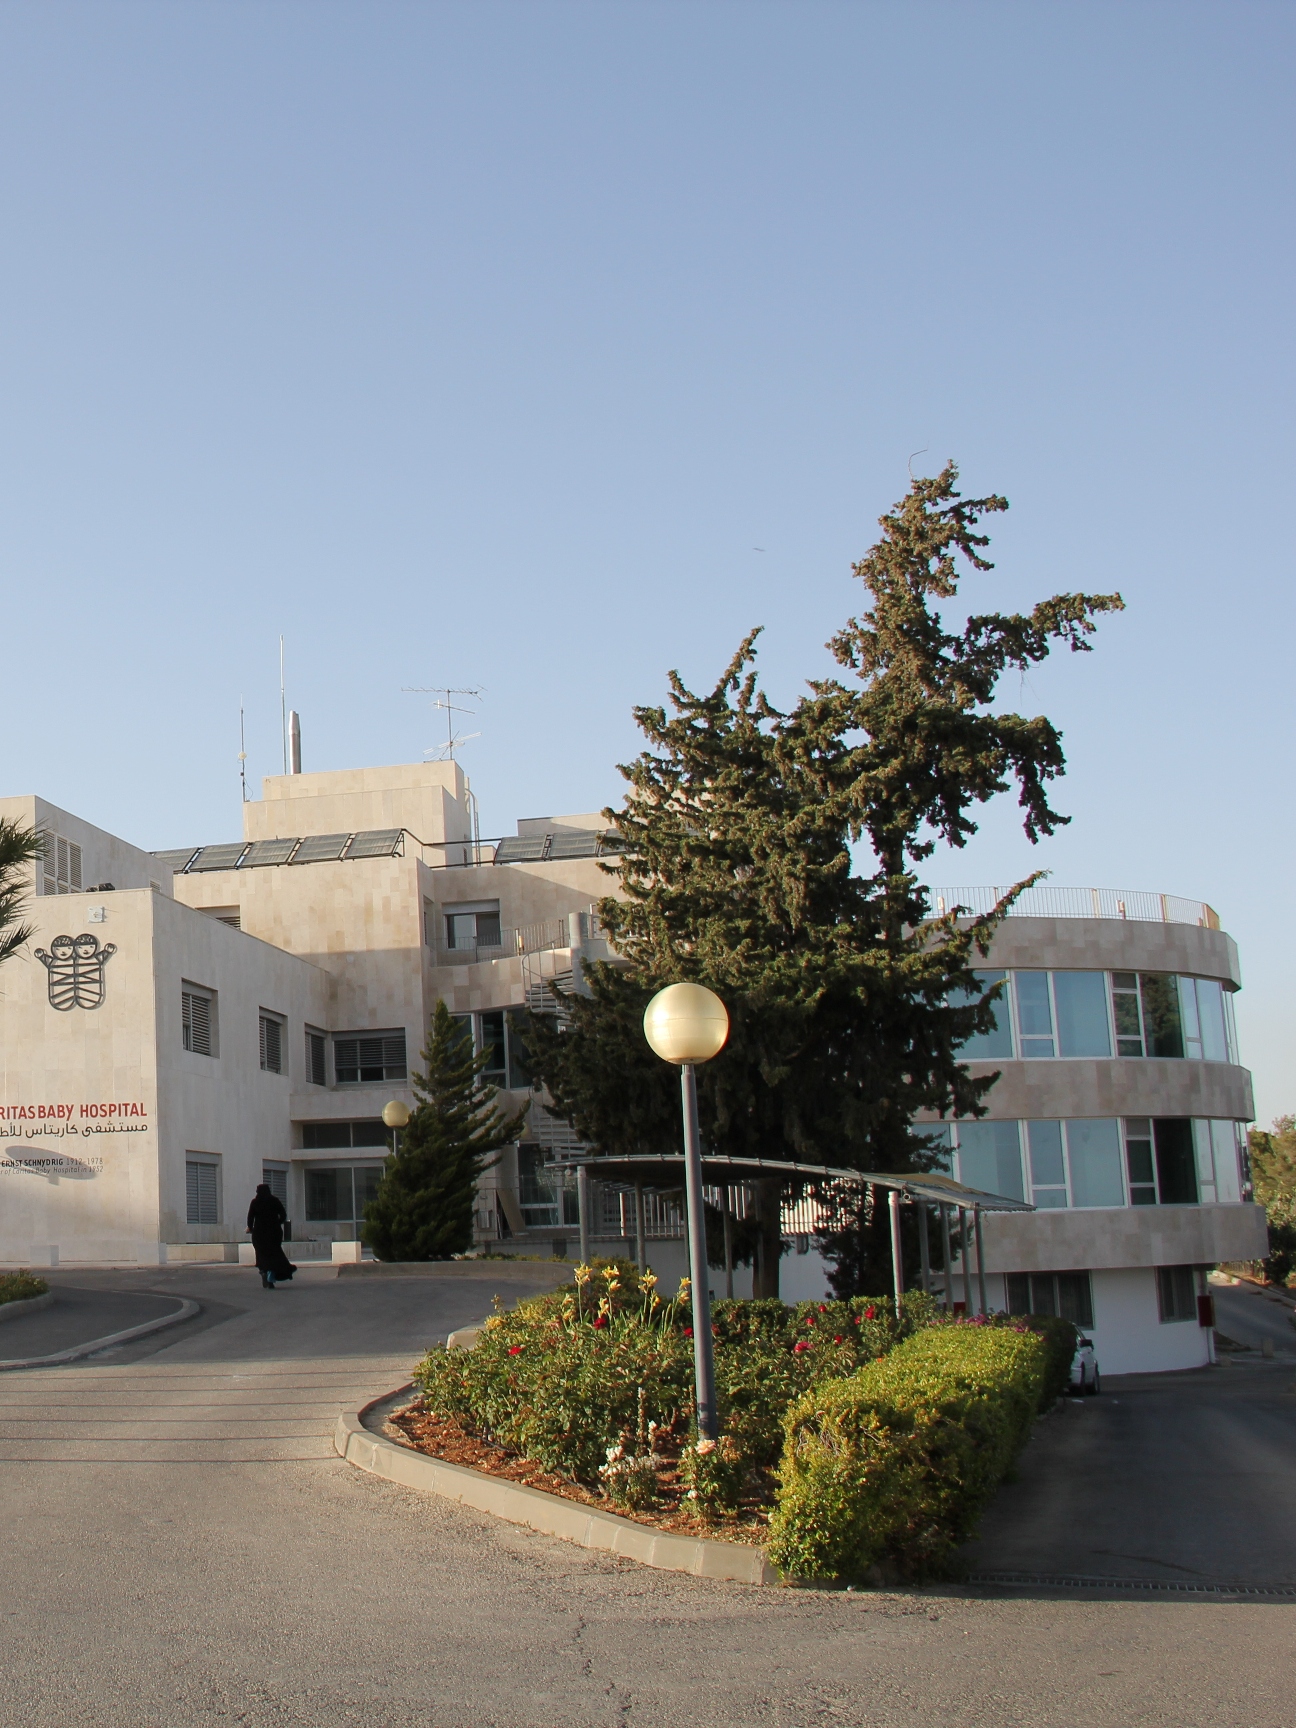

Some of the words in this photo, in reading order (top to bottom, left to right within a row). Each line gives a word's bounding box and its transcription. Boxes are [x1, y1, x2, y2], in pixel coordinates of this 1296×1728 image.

[37, 1104, 75, 1121] BABY
[79, 1102, 148, 1118] HOSPITAL
[25, 1122, 79, 1138] كاريتاس
[81, 1120, 149, 1137] مستشفى
[1, 1159, 22, 1168] ERNST
[24, 1158, 63, 1168] SCHNYDRIG
[5, 1168, 12, 1177] of
[53, 1165, 80, 1175] Hospital
